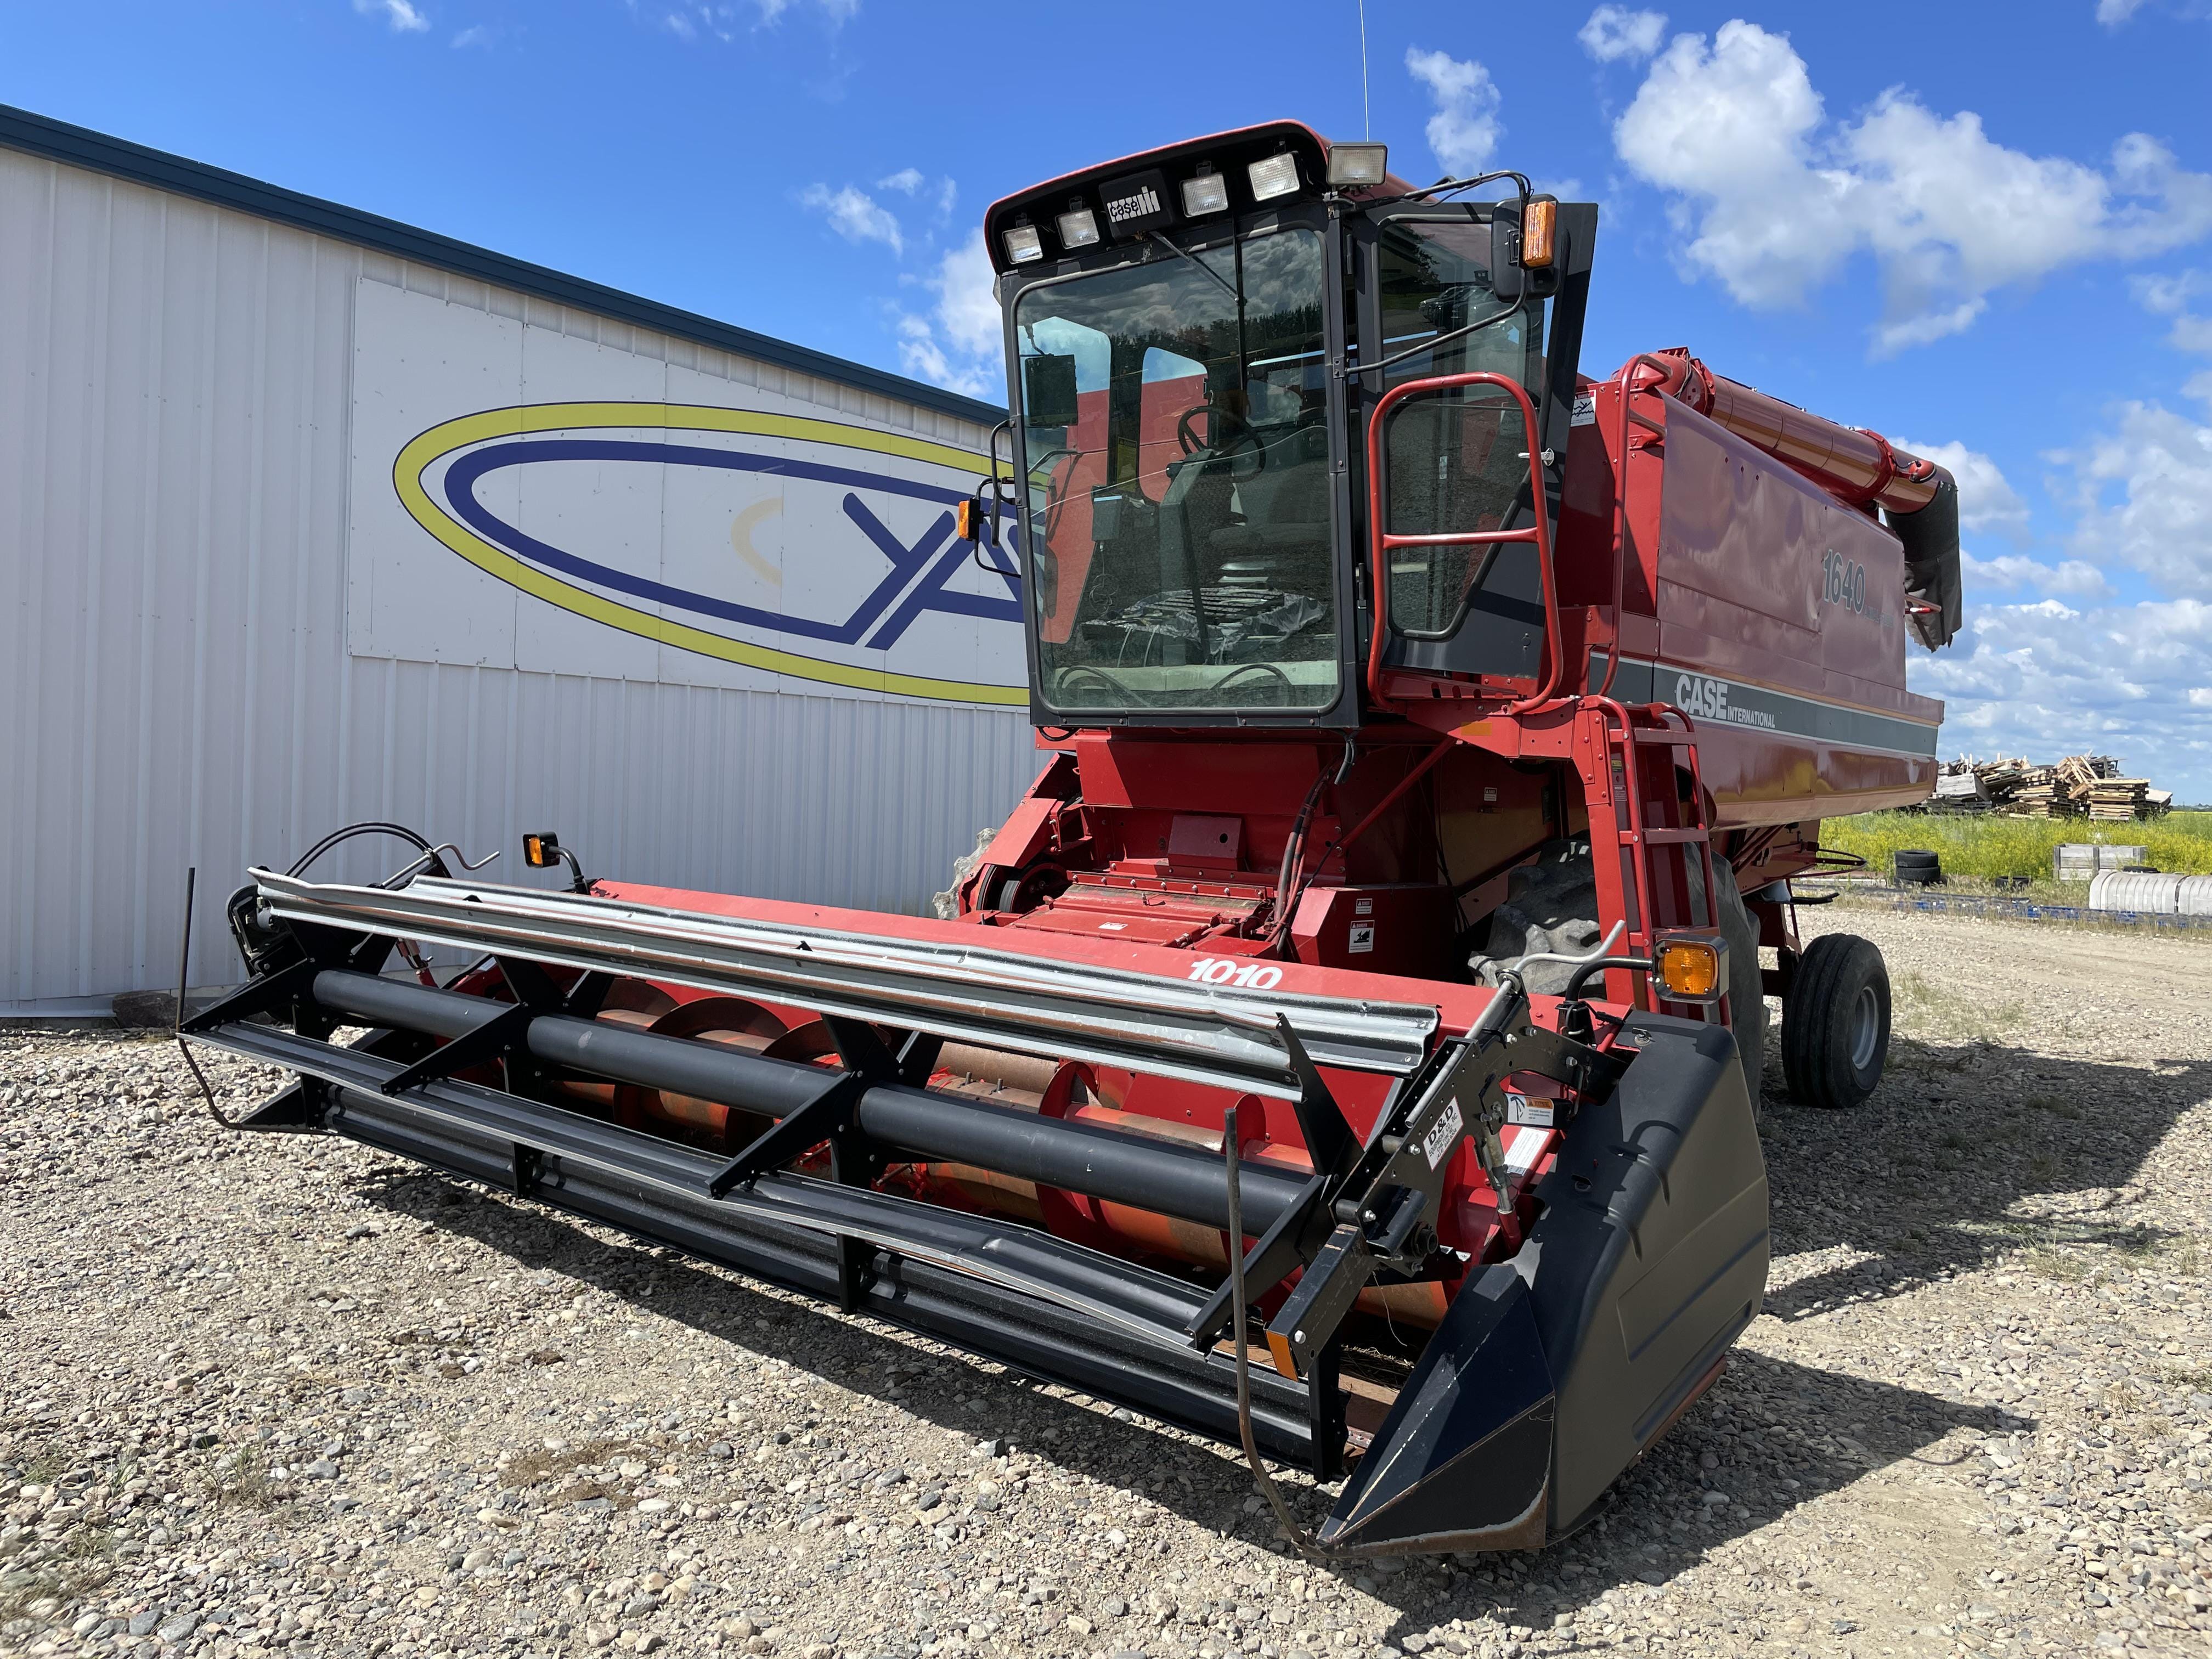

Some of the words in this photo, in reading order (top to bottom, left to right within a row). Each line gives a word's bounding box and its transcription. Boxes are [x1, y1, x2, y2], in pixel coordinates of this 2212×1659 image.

[1824, 549, 1865, 614] 1640
[1676, 674, 1728, 719] CASE
[1728, 706, 1775, 728] INTERNATIONAL
[1188, 958, 1283, 989] 1010
[1429, 1130, 1445, 1158] EQUIPMENT
